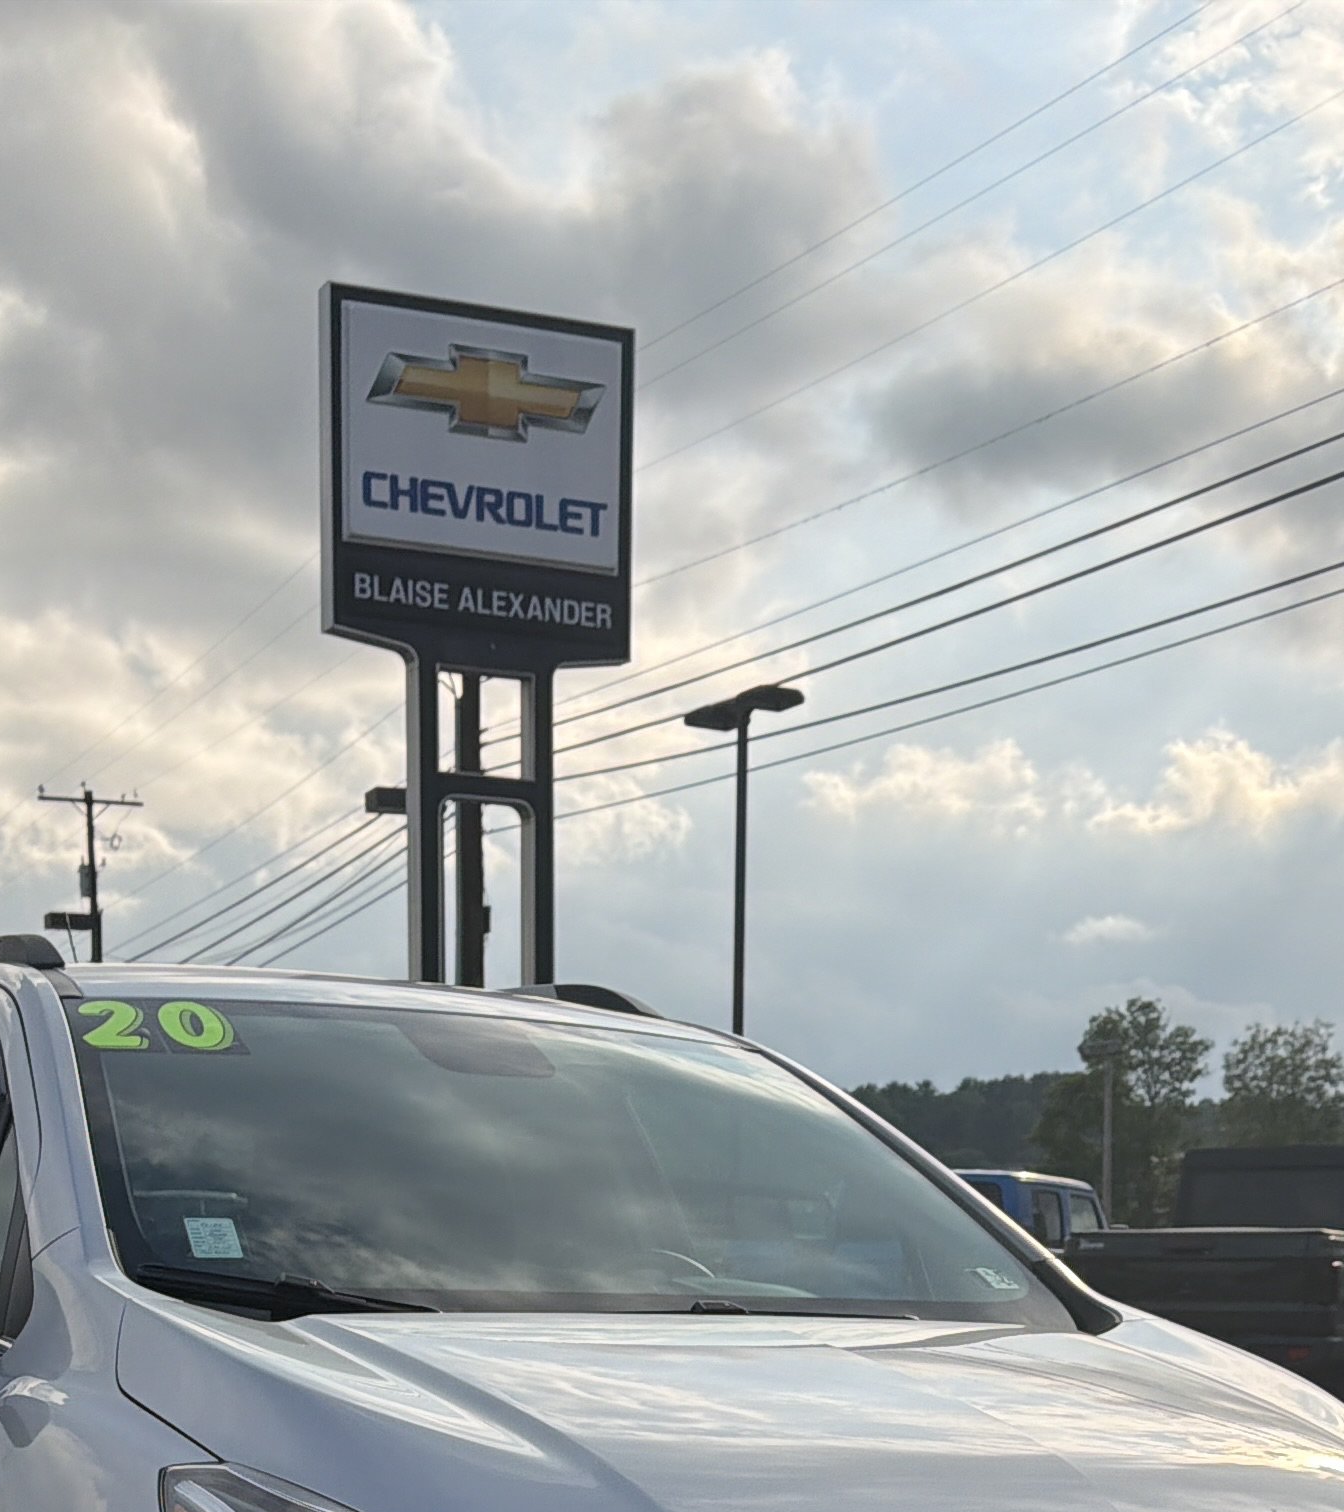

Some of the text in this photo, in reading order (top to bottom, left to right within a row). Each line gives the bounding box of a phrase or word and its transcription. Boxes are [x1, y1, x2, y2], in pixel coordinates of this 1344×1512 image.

[362, 471, 608, 537] CHEVROLET
[354, 572, 613, 629] BLAISE ALEXANDER
[78, 1000, 234, 1050] 20
